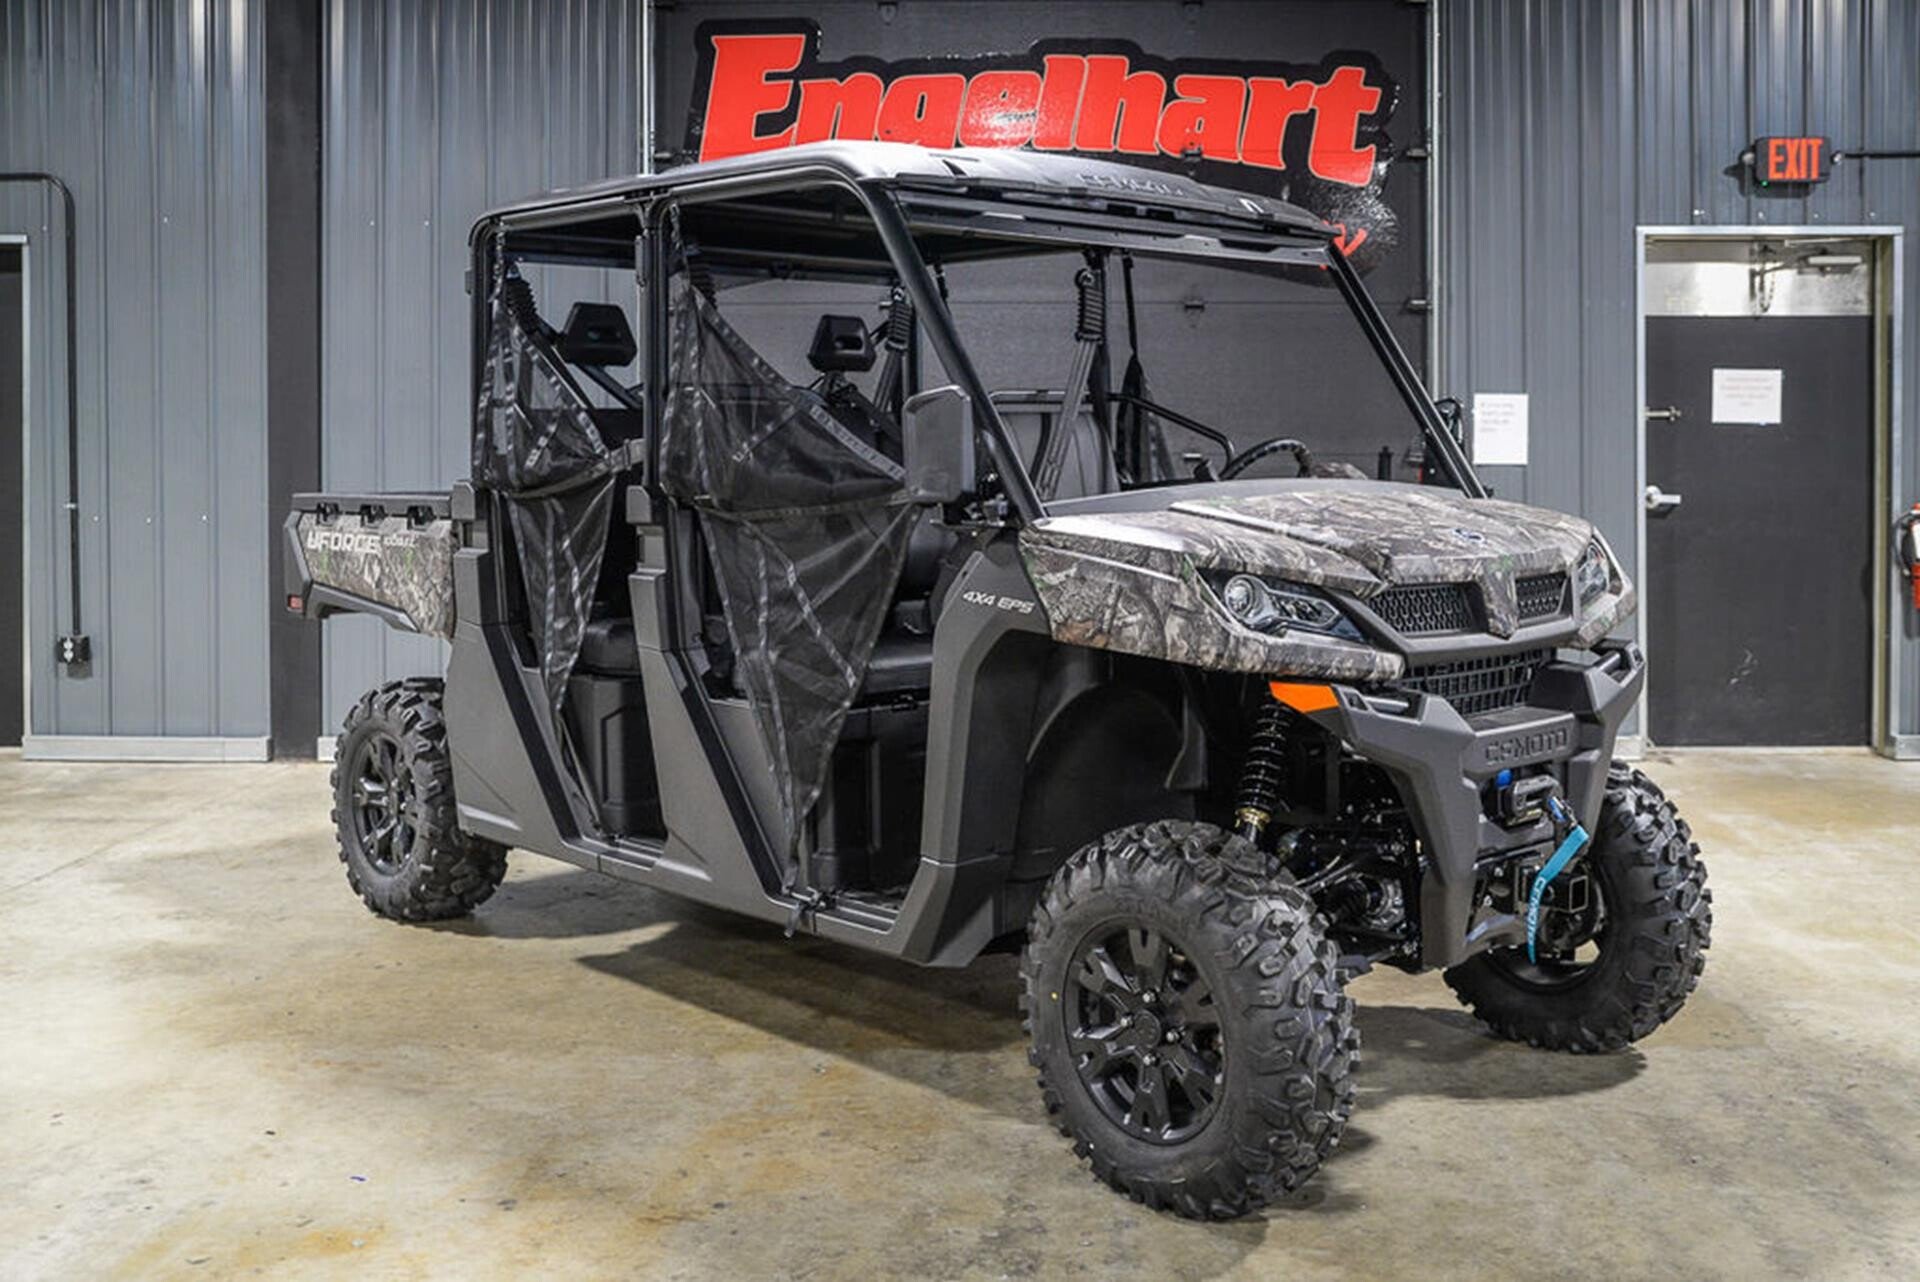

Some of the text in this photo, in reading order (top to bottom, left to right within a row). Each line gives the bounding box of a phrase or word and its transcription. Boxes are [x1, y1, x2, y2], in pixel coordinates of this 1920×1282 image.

[700, 34, 1382, 187] Engelhart
[1768, 138, 1823, 180] EXIT
[997, 597, 1035, 614] EPS
